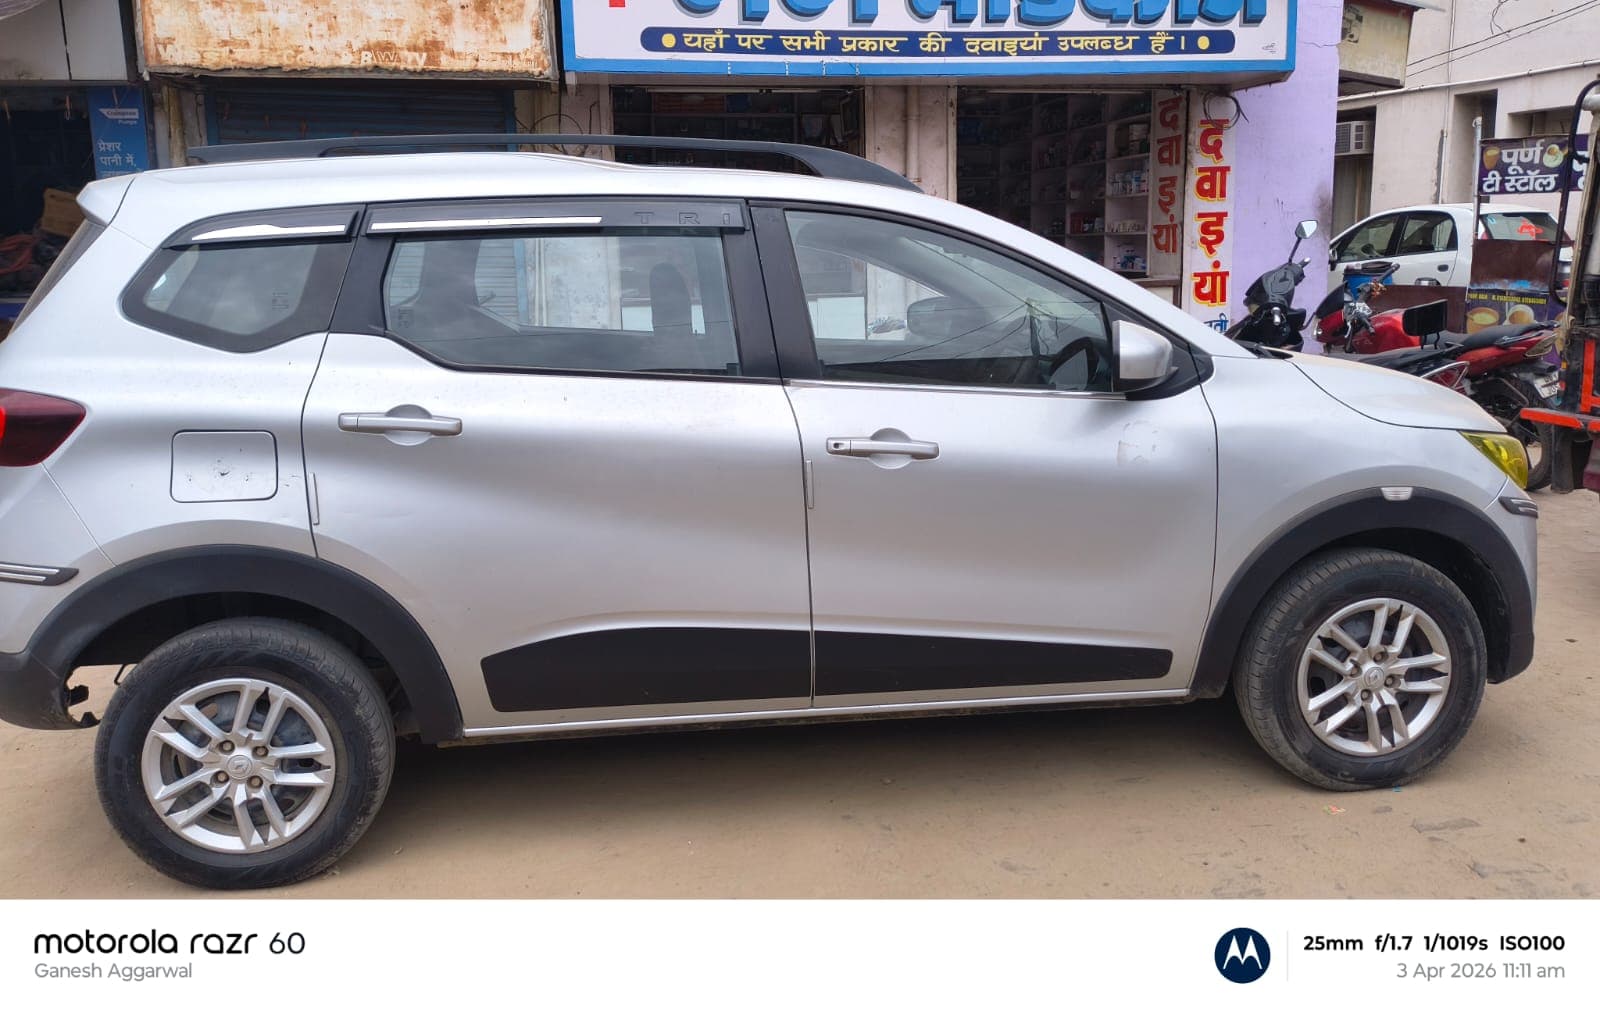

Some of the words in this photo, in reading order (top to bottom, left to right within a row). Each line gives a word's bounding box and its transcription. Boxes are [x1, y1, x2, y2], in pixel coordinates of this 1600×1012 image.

[684, 29, 730, 52] यहाँ
[735, 34, 772, 49] पर
[780, 31, 830, 51] सभी
[838, 36, 908, 53] प्रकार
[919, 32, 952, 53] की
[963, 32, 1049, 56] दवाइयां
[1057, 35, 1139, 51] उपलब्ध
[99, 154, 122, 166] पानी
[1482, 170, 1502, 193] टी
[1504, 169, 1559, 192] स्टॉल
[1192, 118, 1231, 307] दवाइयां
